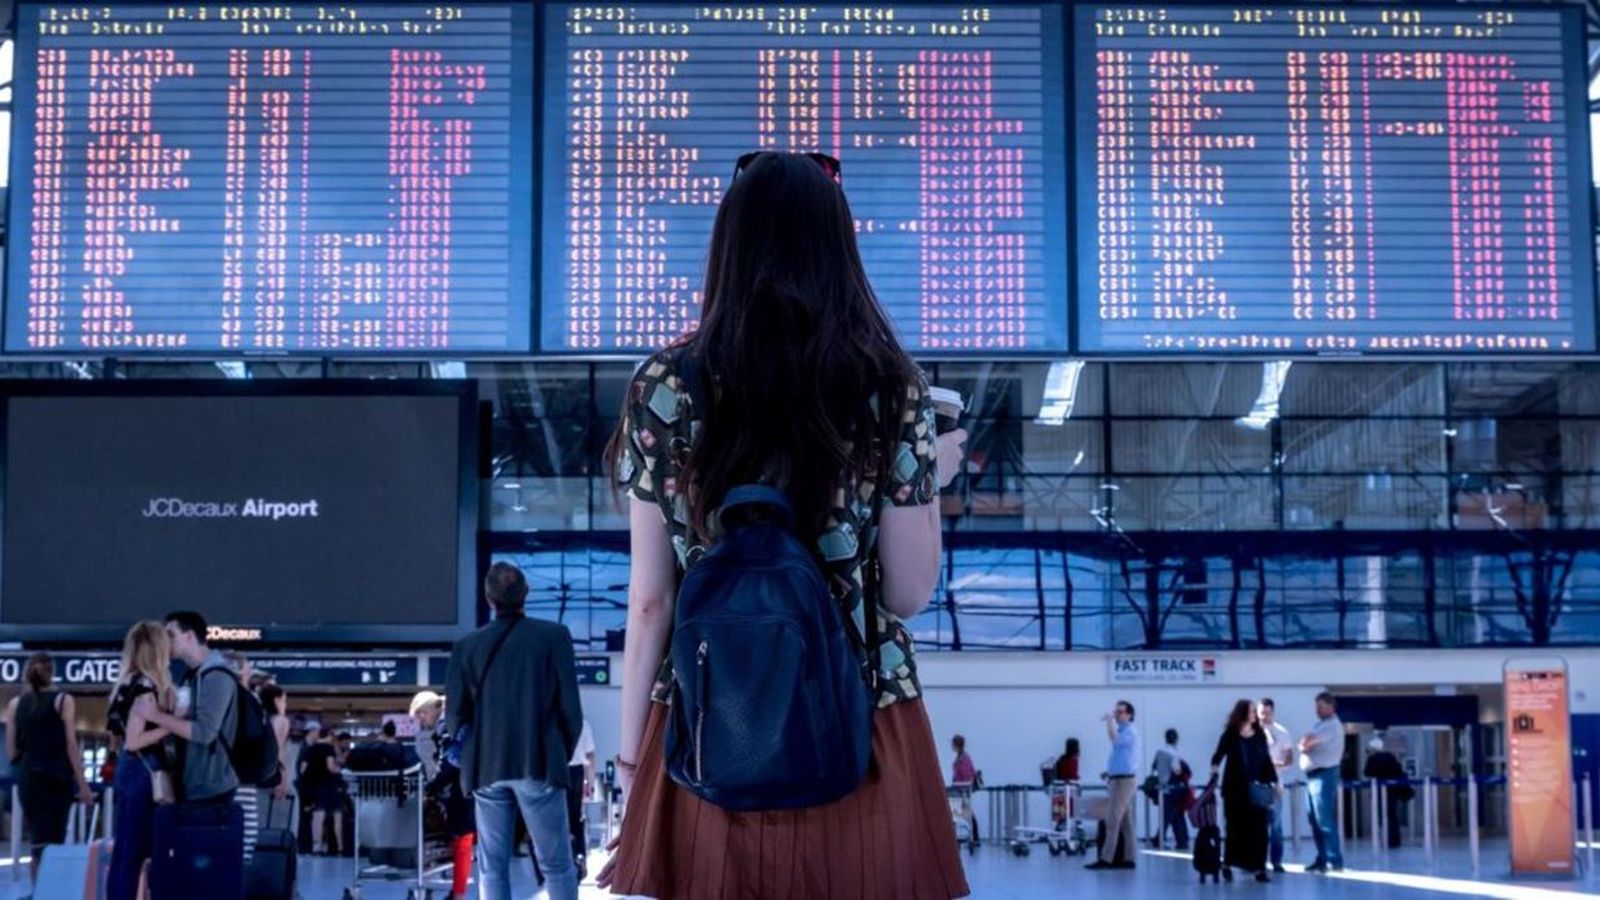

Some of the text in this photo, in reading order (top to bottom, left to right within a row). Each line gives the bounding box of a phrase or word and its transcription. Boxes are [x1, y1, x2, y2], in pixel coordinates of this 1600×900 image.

[142, 498, 319, 520] JCDecaux Airport
[0, 659, 20, 682] O
[1114, 659, 1196, 672] FAST TRACK
